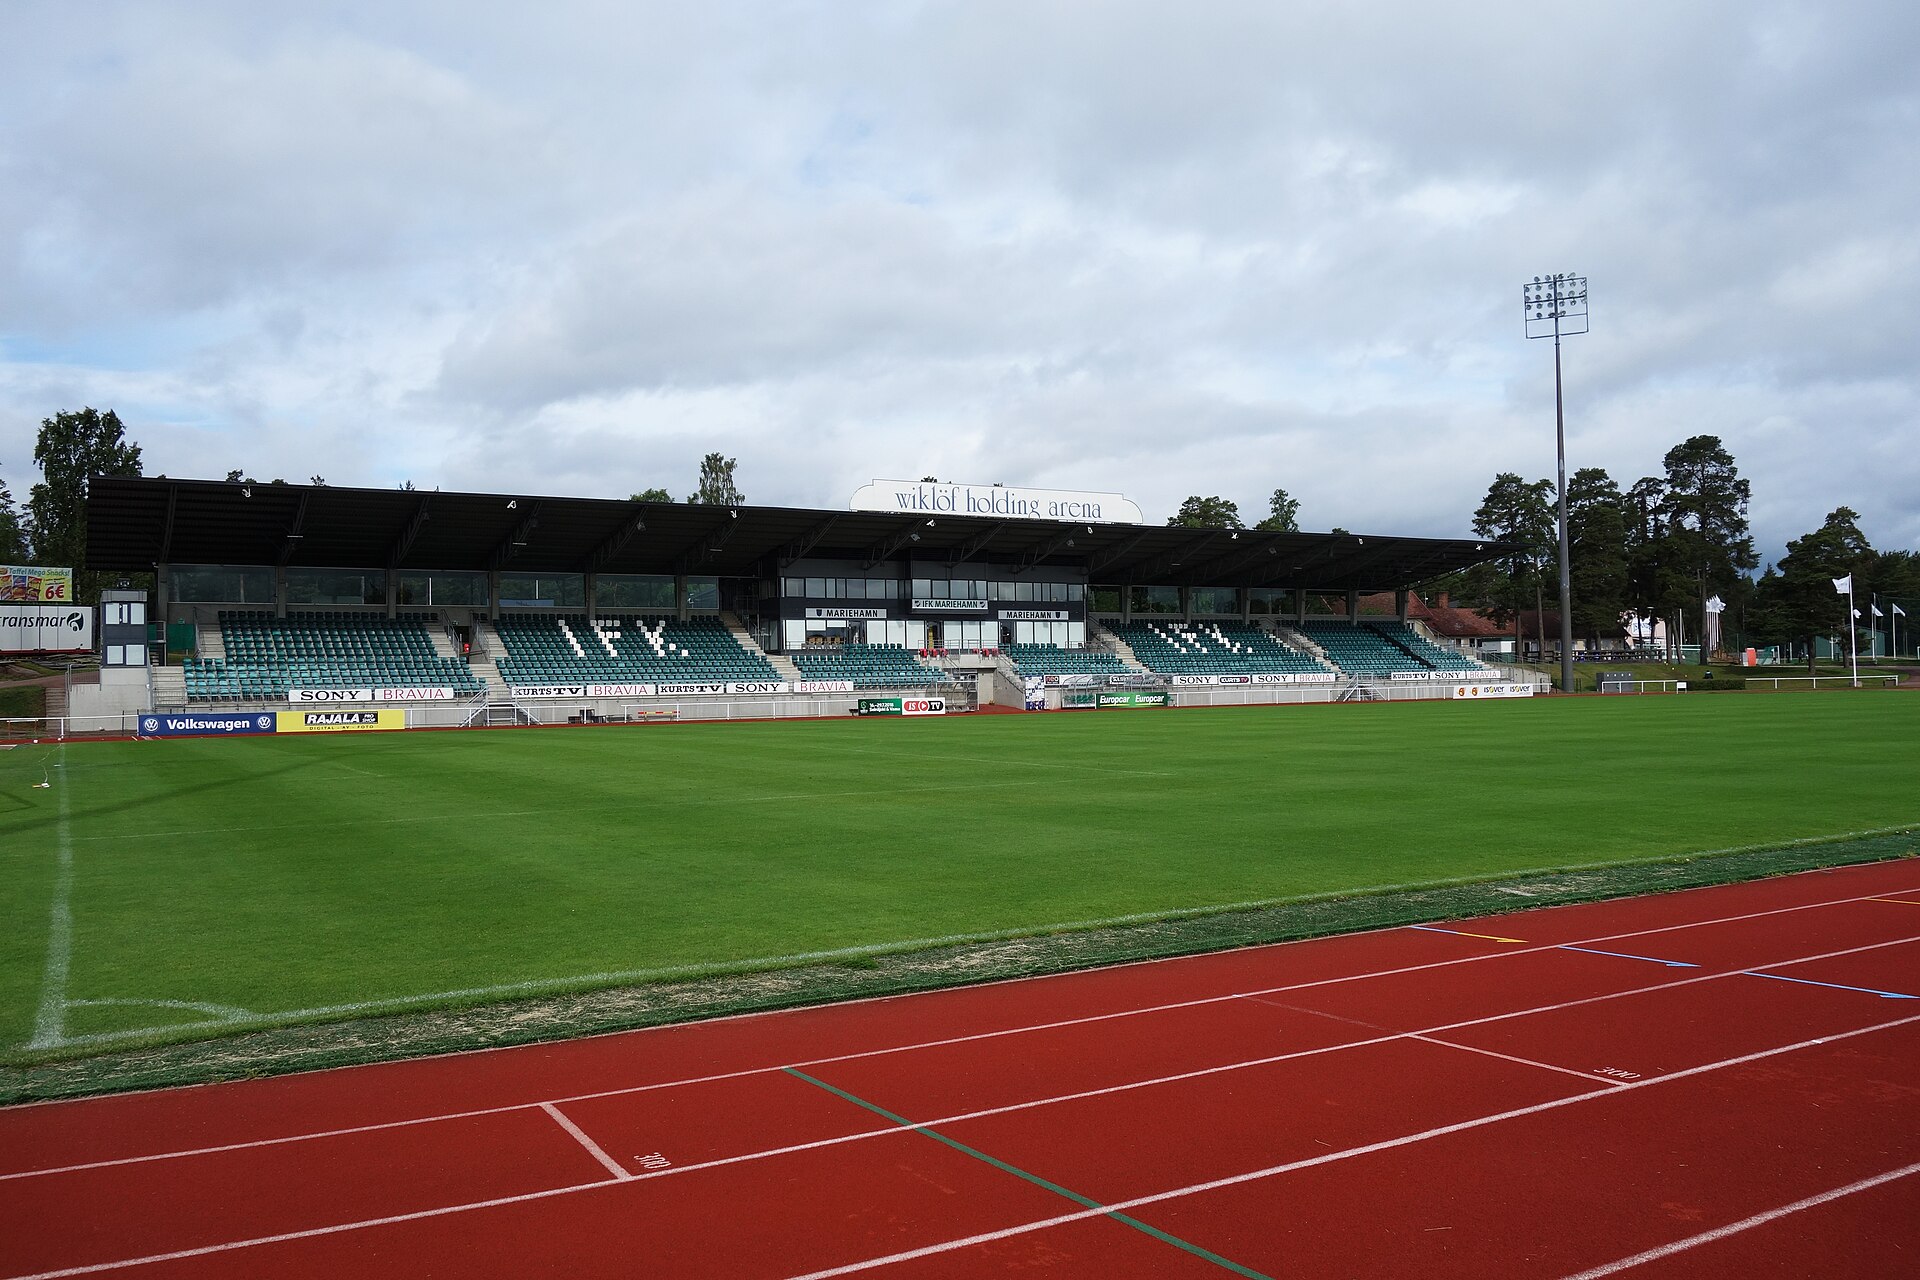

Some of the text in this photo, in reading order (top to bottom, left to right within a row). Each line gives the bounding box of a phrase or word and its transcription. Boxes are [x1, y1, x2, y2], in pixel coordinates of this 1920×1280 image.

[895, 485, 1102, 518] wiklöf holding arena
[45, 585, 65, 600] 6€
[922, 600, 978, 609] IFK MARIEHAMN
[826, 608, 878, 618] MARIEHAMN
[1006, 611, 1051, 620] MARIEHAMN
[0, 615, 66, 628] ransmar
[1179, 676, 1212, 684] SONY
[1300, 674, 1331, 682] BRAVIA
[594, 685, 648, 695] BRAVIA
[735, 684, 780, 692] SONY
[801, 682, 847, 692] BRAVIA
[300, 690, 361, 701] SONY
[383, 689, 445, 700] BRAVIA
[1135, 694, 1164, 704] Europcar
[1099, 695, 1130, 705] Europcar
[908, 702, 916, 710] IS
[930, 702, 941, 710] TV
[306, 713, 360, 724] RAJALA
[166, 718, 250, 732] Volkswagen
[1593, 1065, 1641, 1079] 300
[633, 1152, 672, 1169] 300
